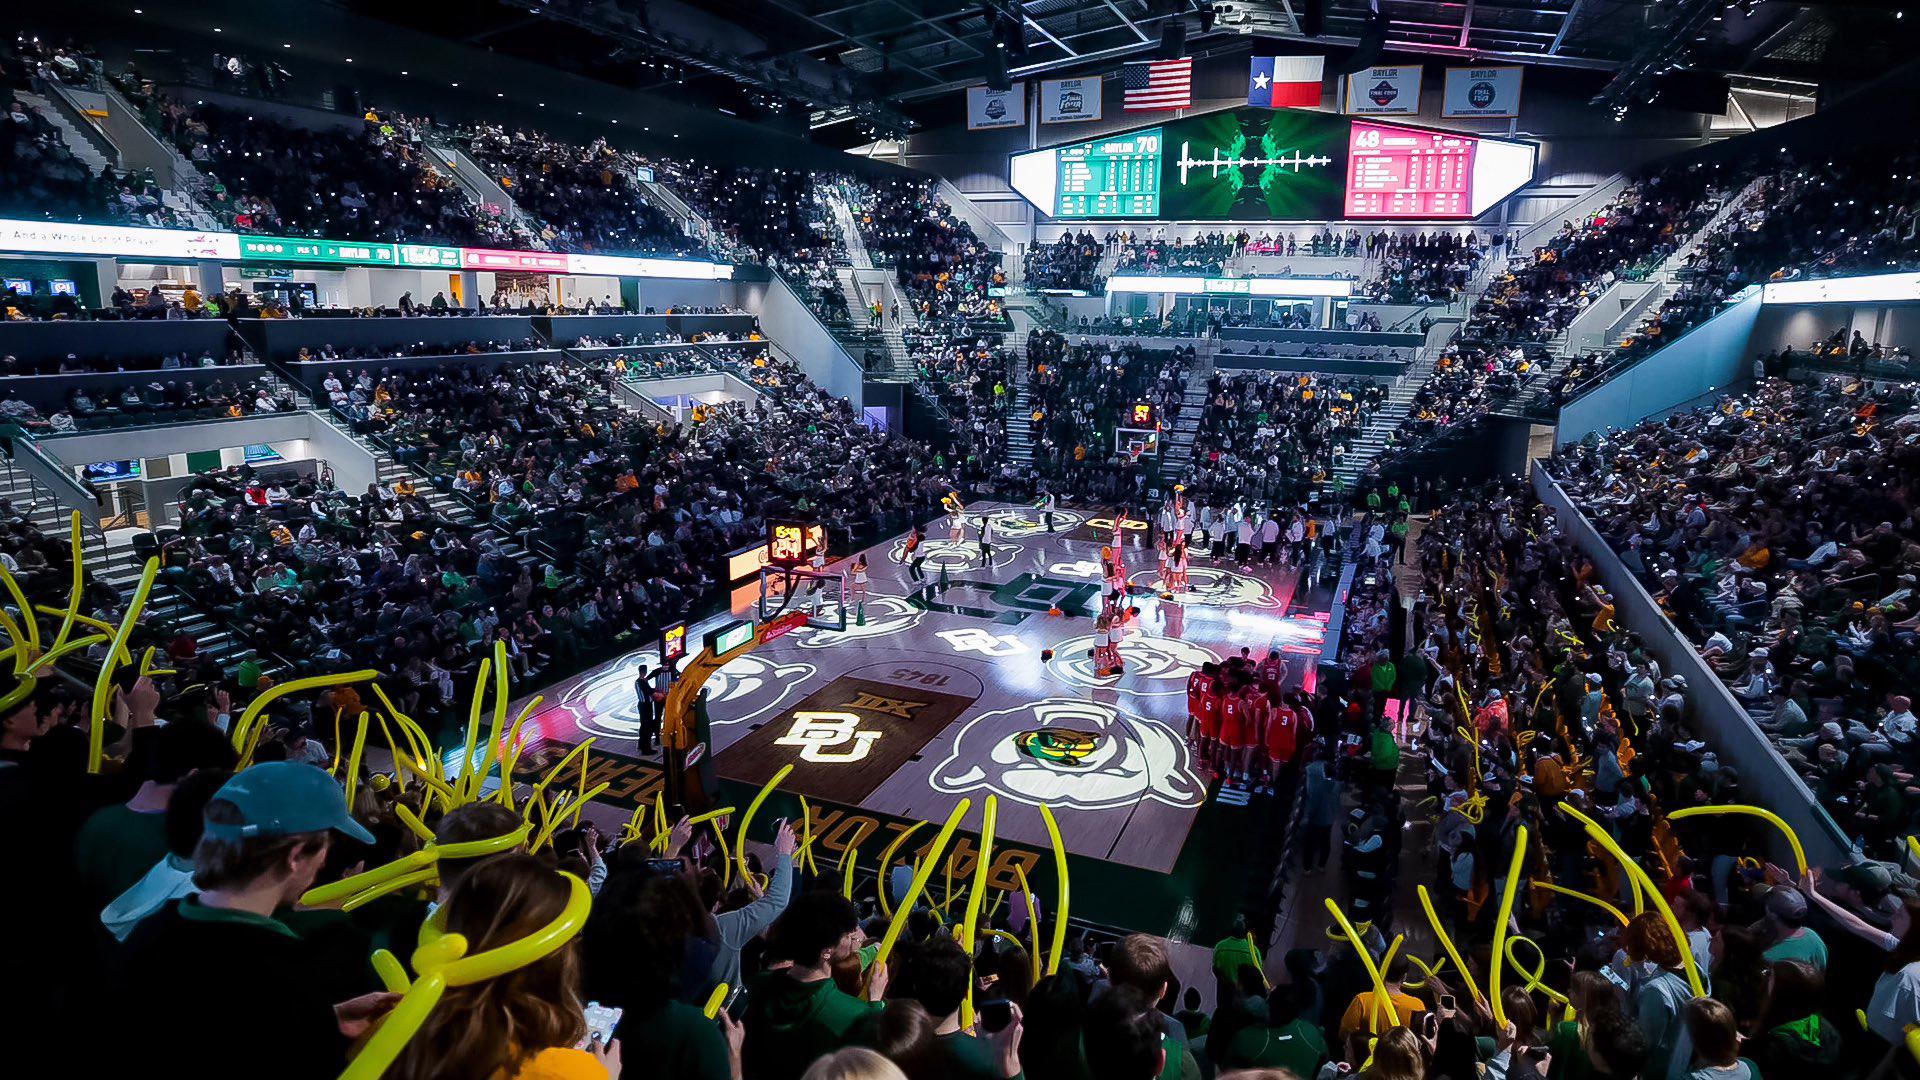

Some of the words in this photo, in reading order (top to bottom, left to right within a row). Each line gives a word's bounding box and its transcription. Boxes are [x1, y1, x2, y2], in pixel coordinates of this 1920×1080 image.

[1471, 70, 1497, 78] BAYLOR
[1061, 80, 1081, 88] BAYLOR
[1104, 142, 1134, 154] BAYLOR
[1136, 136, 1158, 153] 70
[934, 627, 1030, 657] BU
[888, 667, 951, 687] 1845
[839, 691, 930, 719] XII
[1206, 702, 1211, 710] 5
[1228, 705, 1232, 714] 2
[1282, 716, 1288, 725] 3
[773, 711, 884, 763] BU
